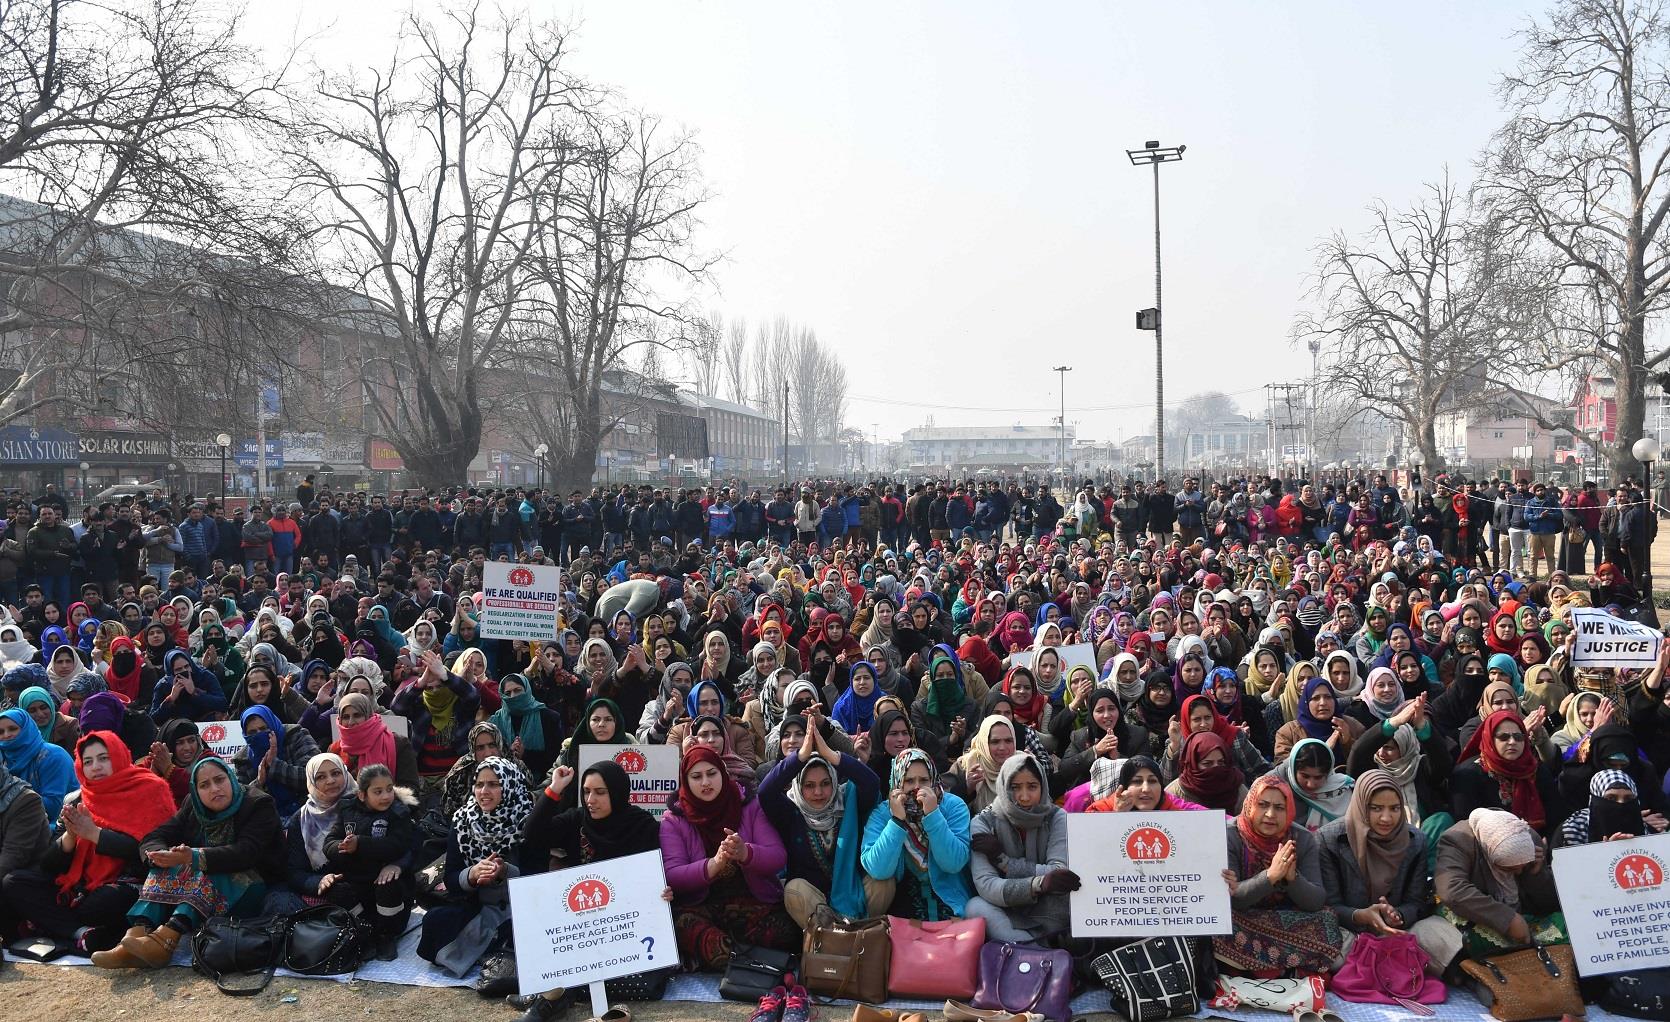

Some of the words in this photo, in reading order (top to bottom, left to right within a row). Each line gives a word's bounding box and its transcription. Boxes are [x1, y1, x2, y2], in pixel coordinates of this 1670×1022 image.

[0, 440, 33, 460] SIAN
[36, 440, 77, 460] STORE
[79, 438, 118, 454] SOLAR
[485, 588, 496, 597] WE
[499, 590, 514, 598] ARE
[516, 591, 557, 601] QUALIFIED
[1582, 622, 1604, 634] WE
[1608, 623, 1646, 635] WANT
[1584, 641, 1648, 653] JUSTICE
[630, 780, 677, 791] UALIFIED
[1120, 826, 1136, 858] NATIONAL
[1163, 828, 1176, 857] MISSION
[1118, 874, 1146, 883] HAVE
[1149, 874, 1201, 882] INVESTED
[1115, 907, 1160, 915] PEOPLE,
[1593, 909, 1611, 917] WE
[1613, 904, 1644, 914] HAVE
[545, 927, 562, 936] WE
[564, 921, 590, 933] HAVE
[592, 911, 640, 926] CROSSED
[1611, 916, 1645, 926] PRIME
[1649, 912, 1665, 921] OF
[551, 933, 585, 945] UPPER
[587, 927, 608, 937] AGE
[610, 921, 636, 932] LIMIT
[1596, 929, 1628, 940] LIVES
[1631, 927, 1642, 935] IN
[553, 945, 573, 954] FOR
[577, 938, 607, 949] GOVT.
[609, 932, 638, 943] JOBS,
[542, 968, 574, 980] WHERE
[575, 965, 588, 973] DO
[605, 959, 618, 967] GO
[620, 954, 640, 964] NOW
[640, 936, 655, 960] ?
[1590, 954, 1613, 963] OUR
[1617, 947, 1670, 960] FAMILIES
